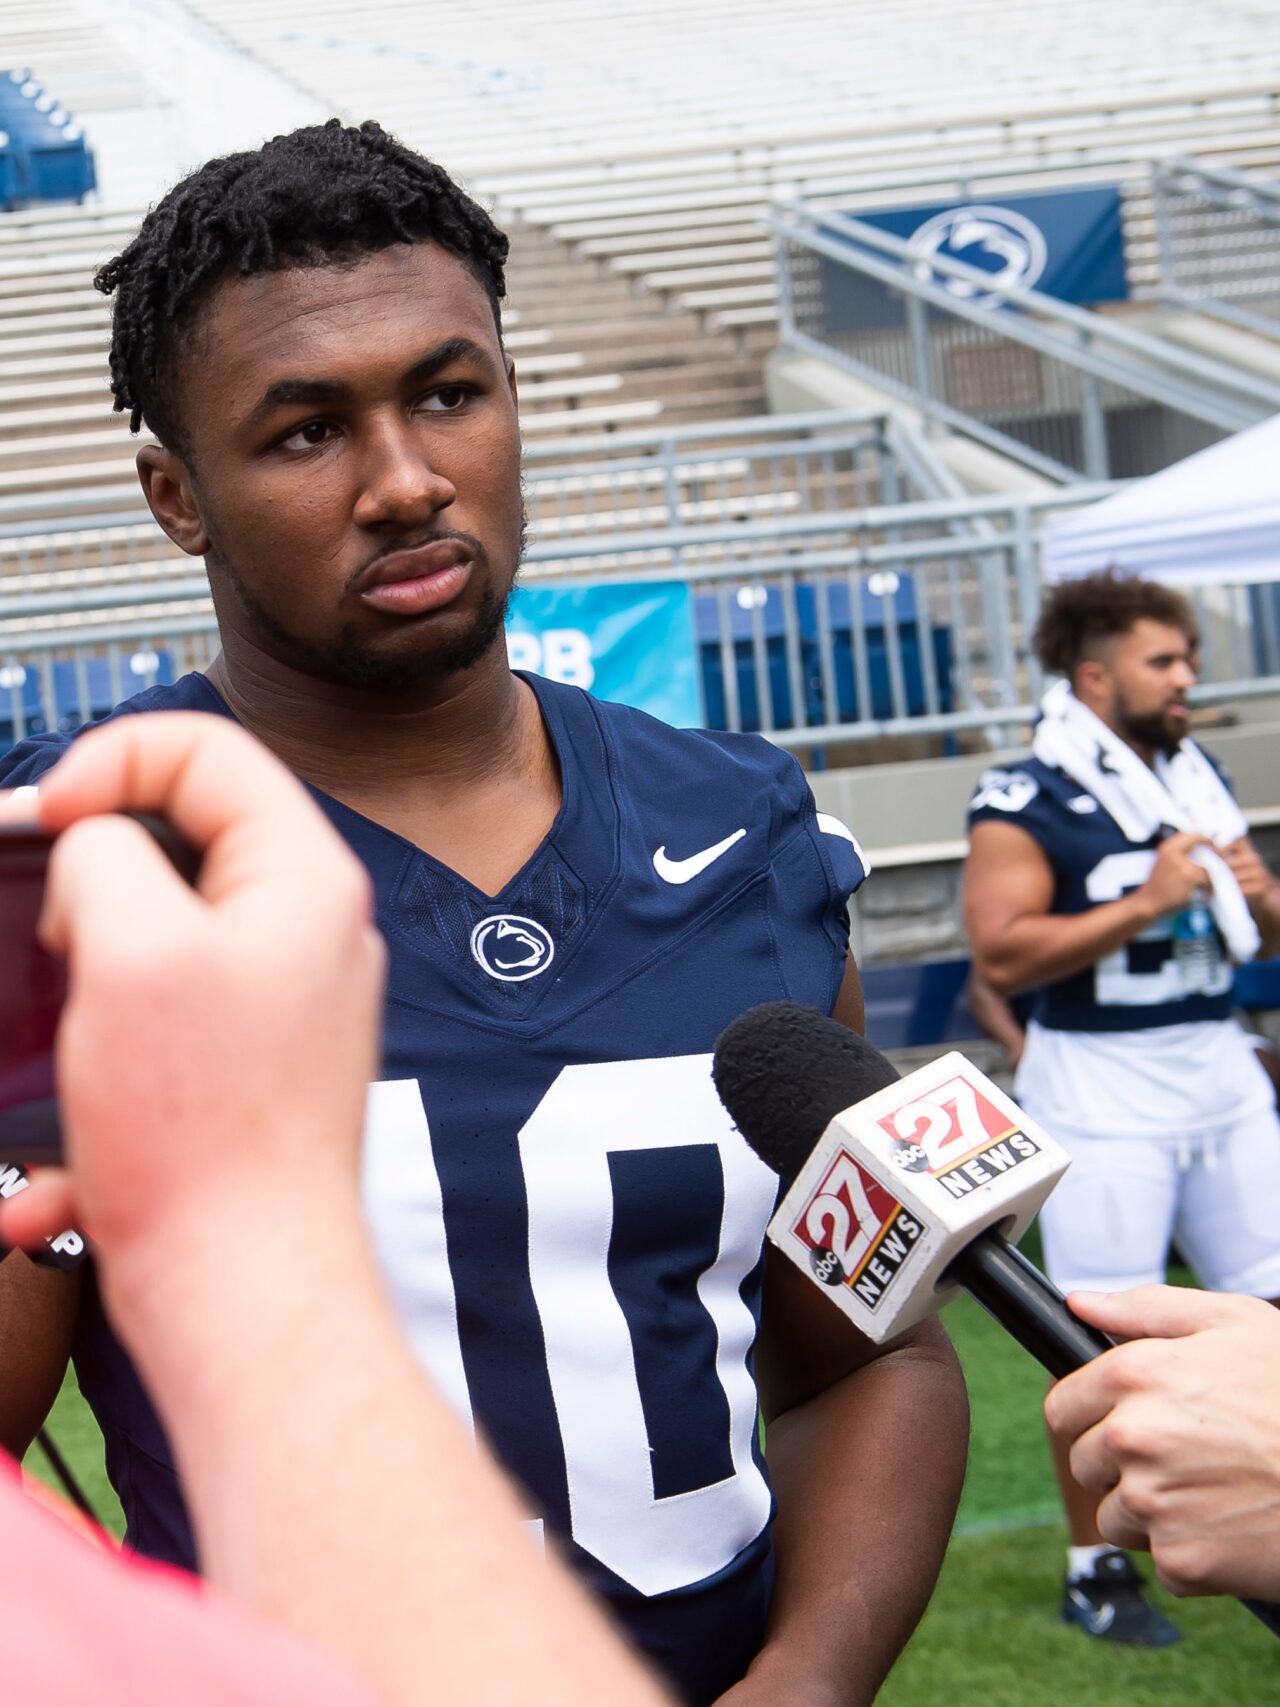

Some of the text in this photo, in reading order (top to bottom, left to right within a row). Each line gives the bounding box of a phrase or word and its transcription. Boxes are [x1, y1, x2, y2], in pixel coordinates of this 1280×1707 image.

[893, 1077, 992, 1170] 27
[939, 1134, 1036, 1197] NEWS
[806, 1155, 882, 1282] abc 27
[855, 1213, 920, 1304] NEWS
